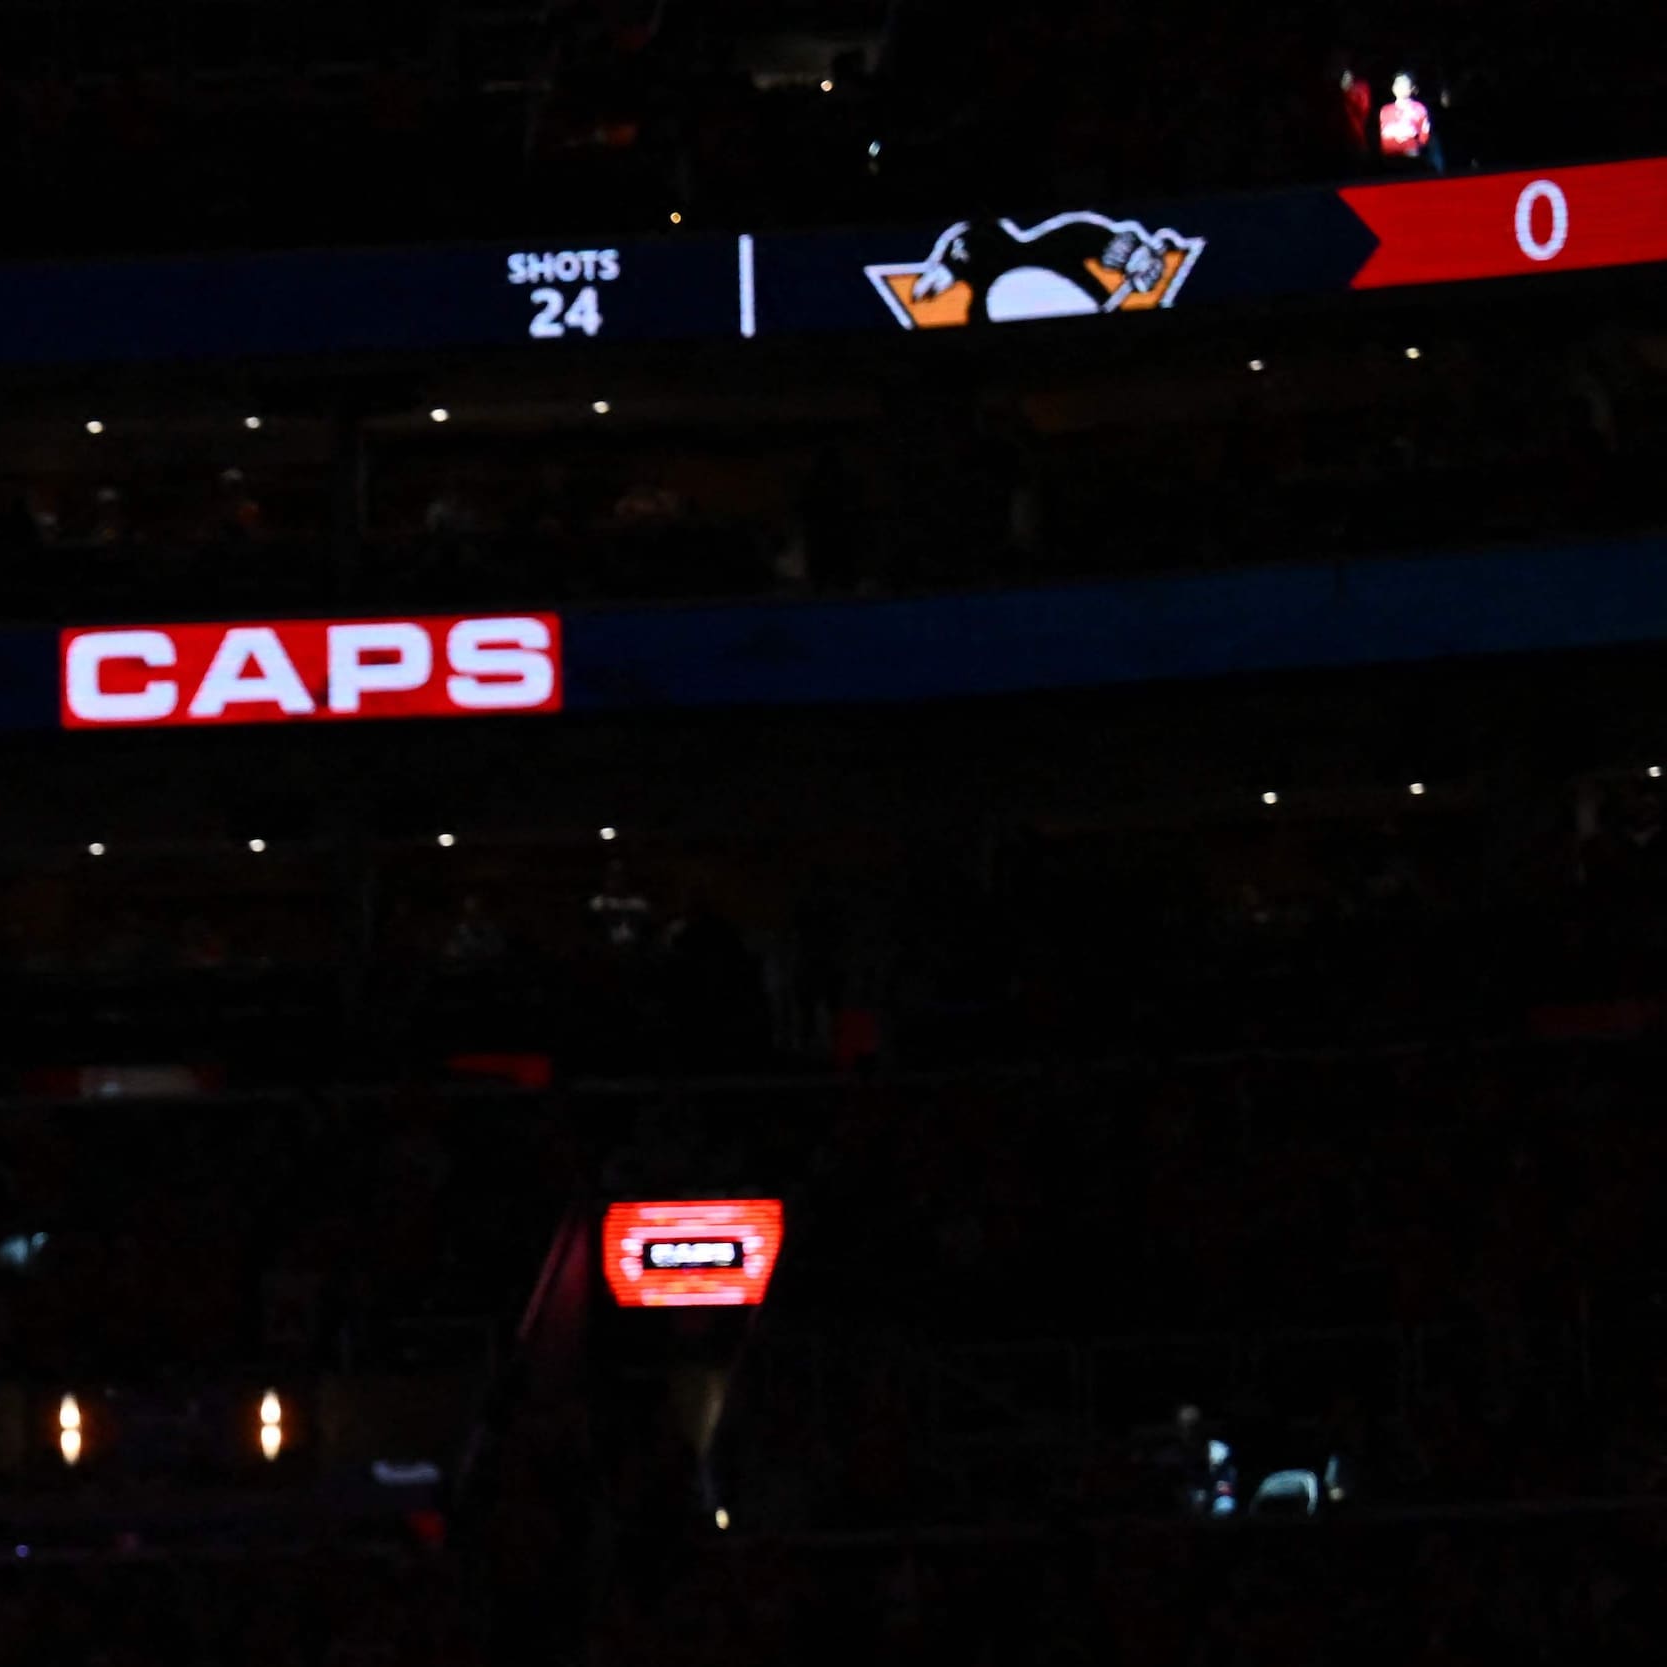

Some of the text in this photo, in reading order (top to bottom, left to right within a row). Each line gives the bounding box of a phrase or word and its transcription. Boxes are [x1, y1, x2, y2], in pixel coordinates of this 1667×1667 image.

[1515, 179, 1568, 261] 0
[507, 249, 620, 284] SHOTS
[529, 286, 603, 339] 24
[66, 617, 554, 721] CAPS
